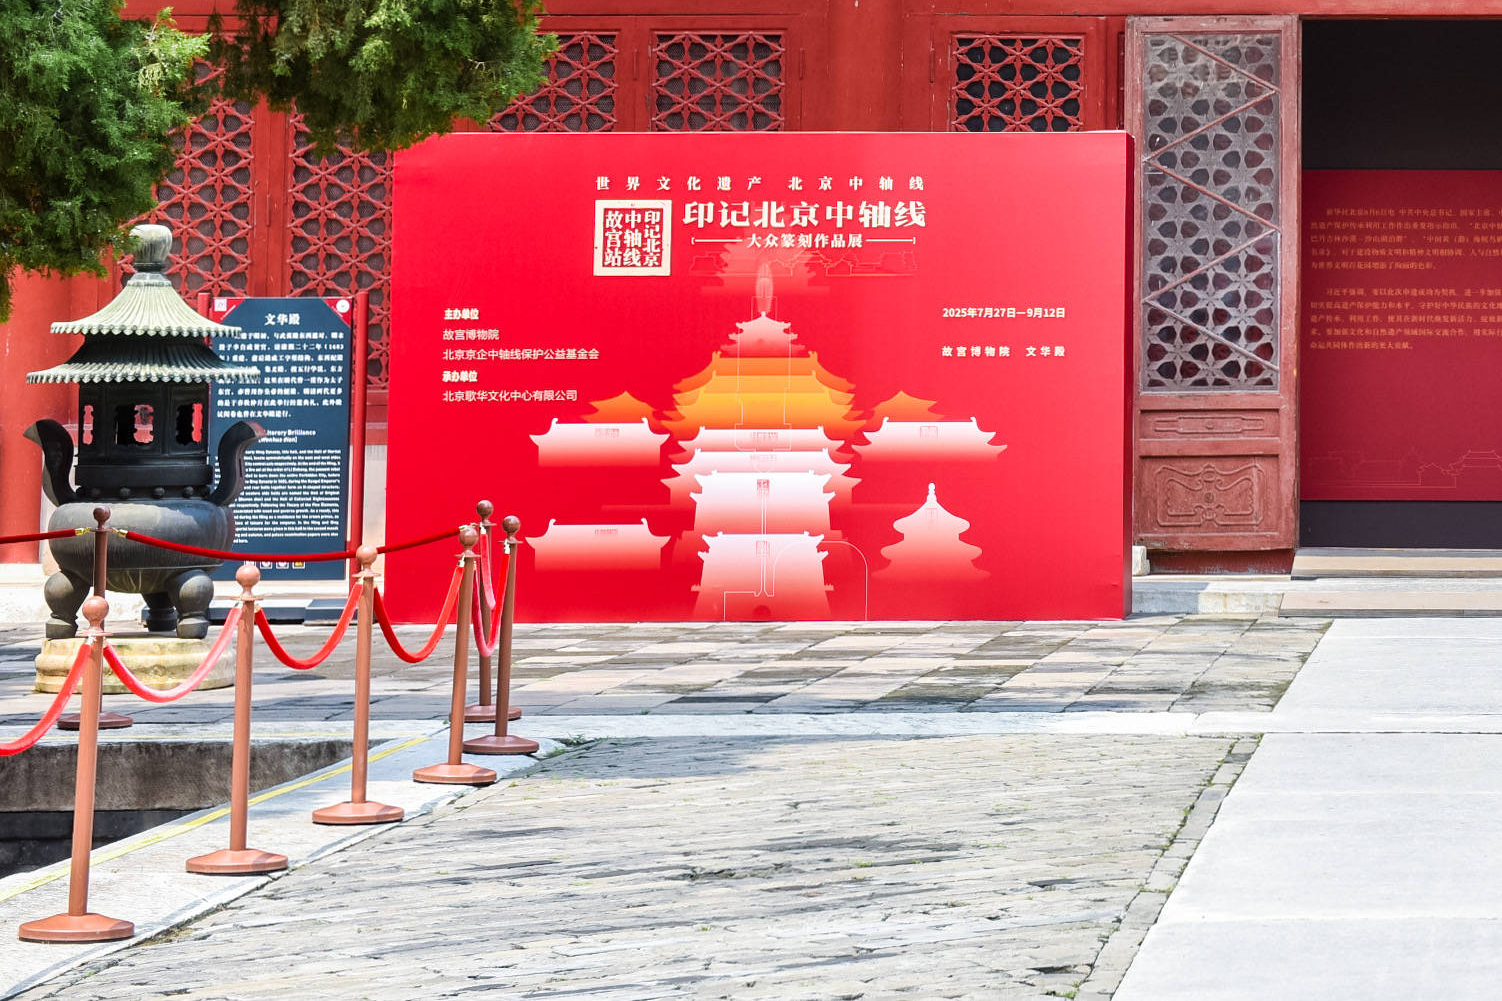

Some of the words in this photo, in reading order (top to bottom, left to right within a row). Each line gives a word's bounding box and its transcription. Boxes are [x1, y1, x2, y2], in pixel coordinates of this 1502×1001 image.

[595, 175, 762, 191] 世界文化遗产
[788, 175, 925, 191] 北京中轴线
[682, 200, 926, 228] 印记北京中轴线
[746, 232, 863, 249] 大众篆刻作品展
[264, 313, 300, 326] 文华殿
[444, 308, 480, 320] 主办单位
[442, 329, 500, 341] 故宫博物院
[442, 348, 600, 360] 北京京企中轴线保护公益基金会
[942, 346, 1011, 357] 故宫博物院
[1026, 346, 1065, 357] 文华殿
[442, 371, 478, 382] 承办单位
[442, 390, 578, 402] 北京歌华文化中心有限公司
[264, 429, 287, 437] iterary
